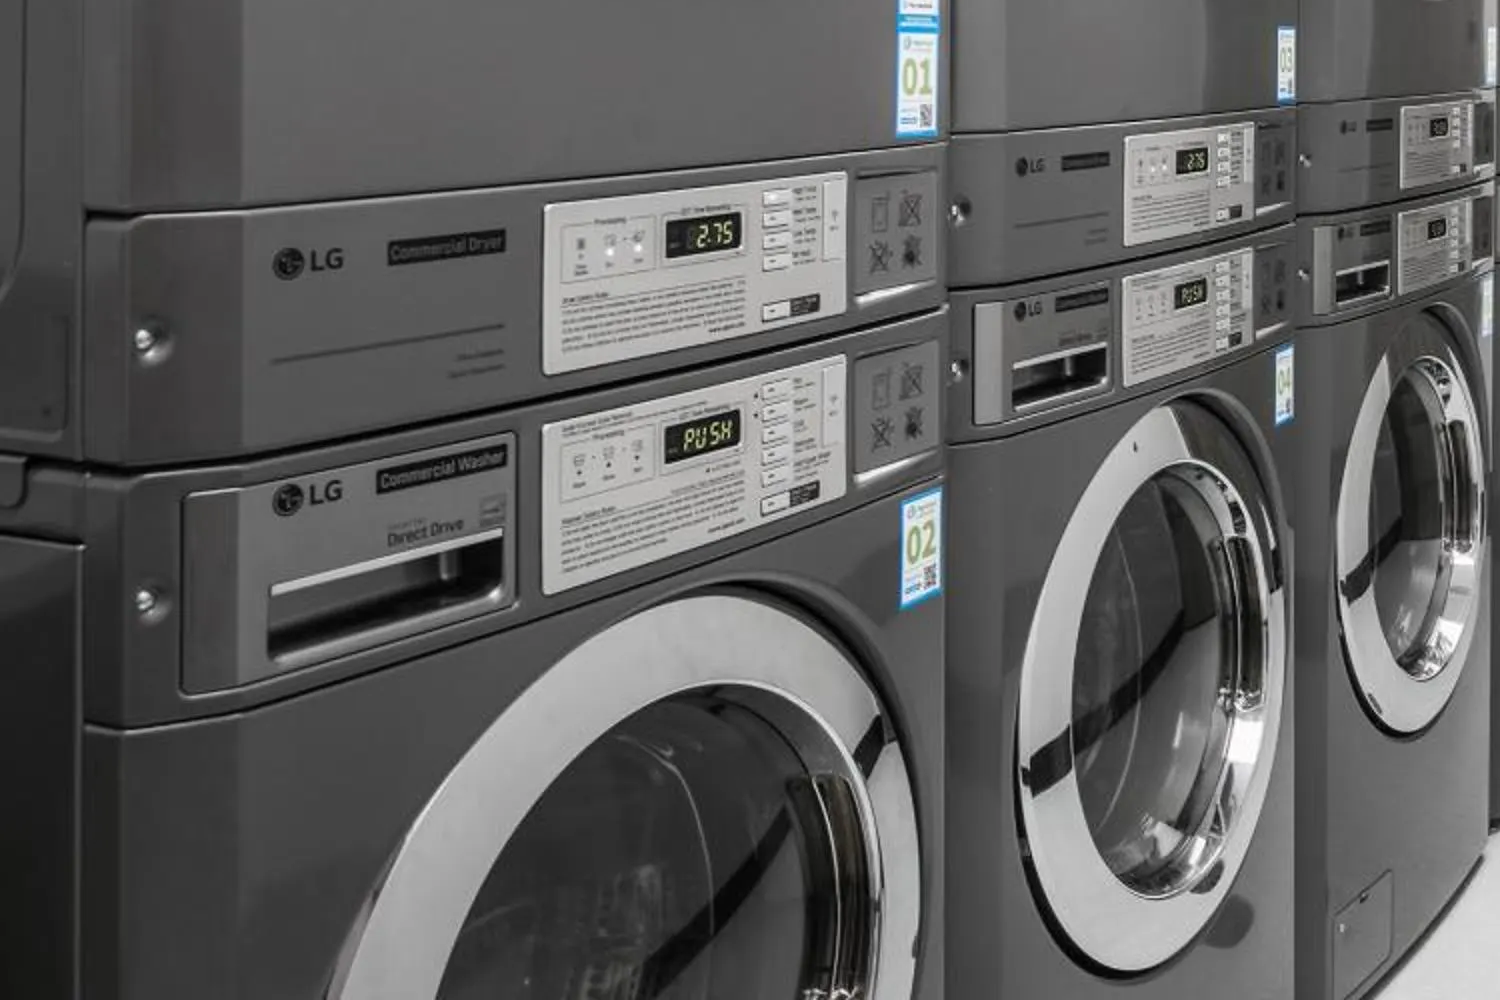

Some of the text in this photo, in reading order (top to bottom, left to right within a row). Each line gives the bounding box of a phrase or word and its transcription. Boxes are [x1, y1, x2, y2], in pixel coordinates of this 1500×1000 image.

[902, 57, 932, 96] 01
[390, 232, 503, 260] Commercial Dryer
[696, 221, 733, 248] 2.75
[309, 248, 344, 271] LG
[683, 419, 734, 451] PUSH
[380, 451, 505, 489] Commercial Washer
[309, 480, 343, 506] LG
[387, 525, 428, 548] Direct
[430, 518, 465, 538] Drive
[907, 519, 937, 565] 02
